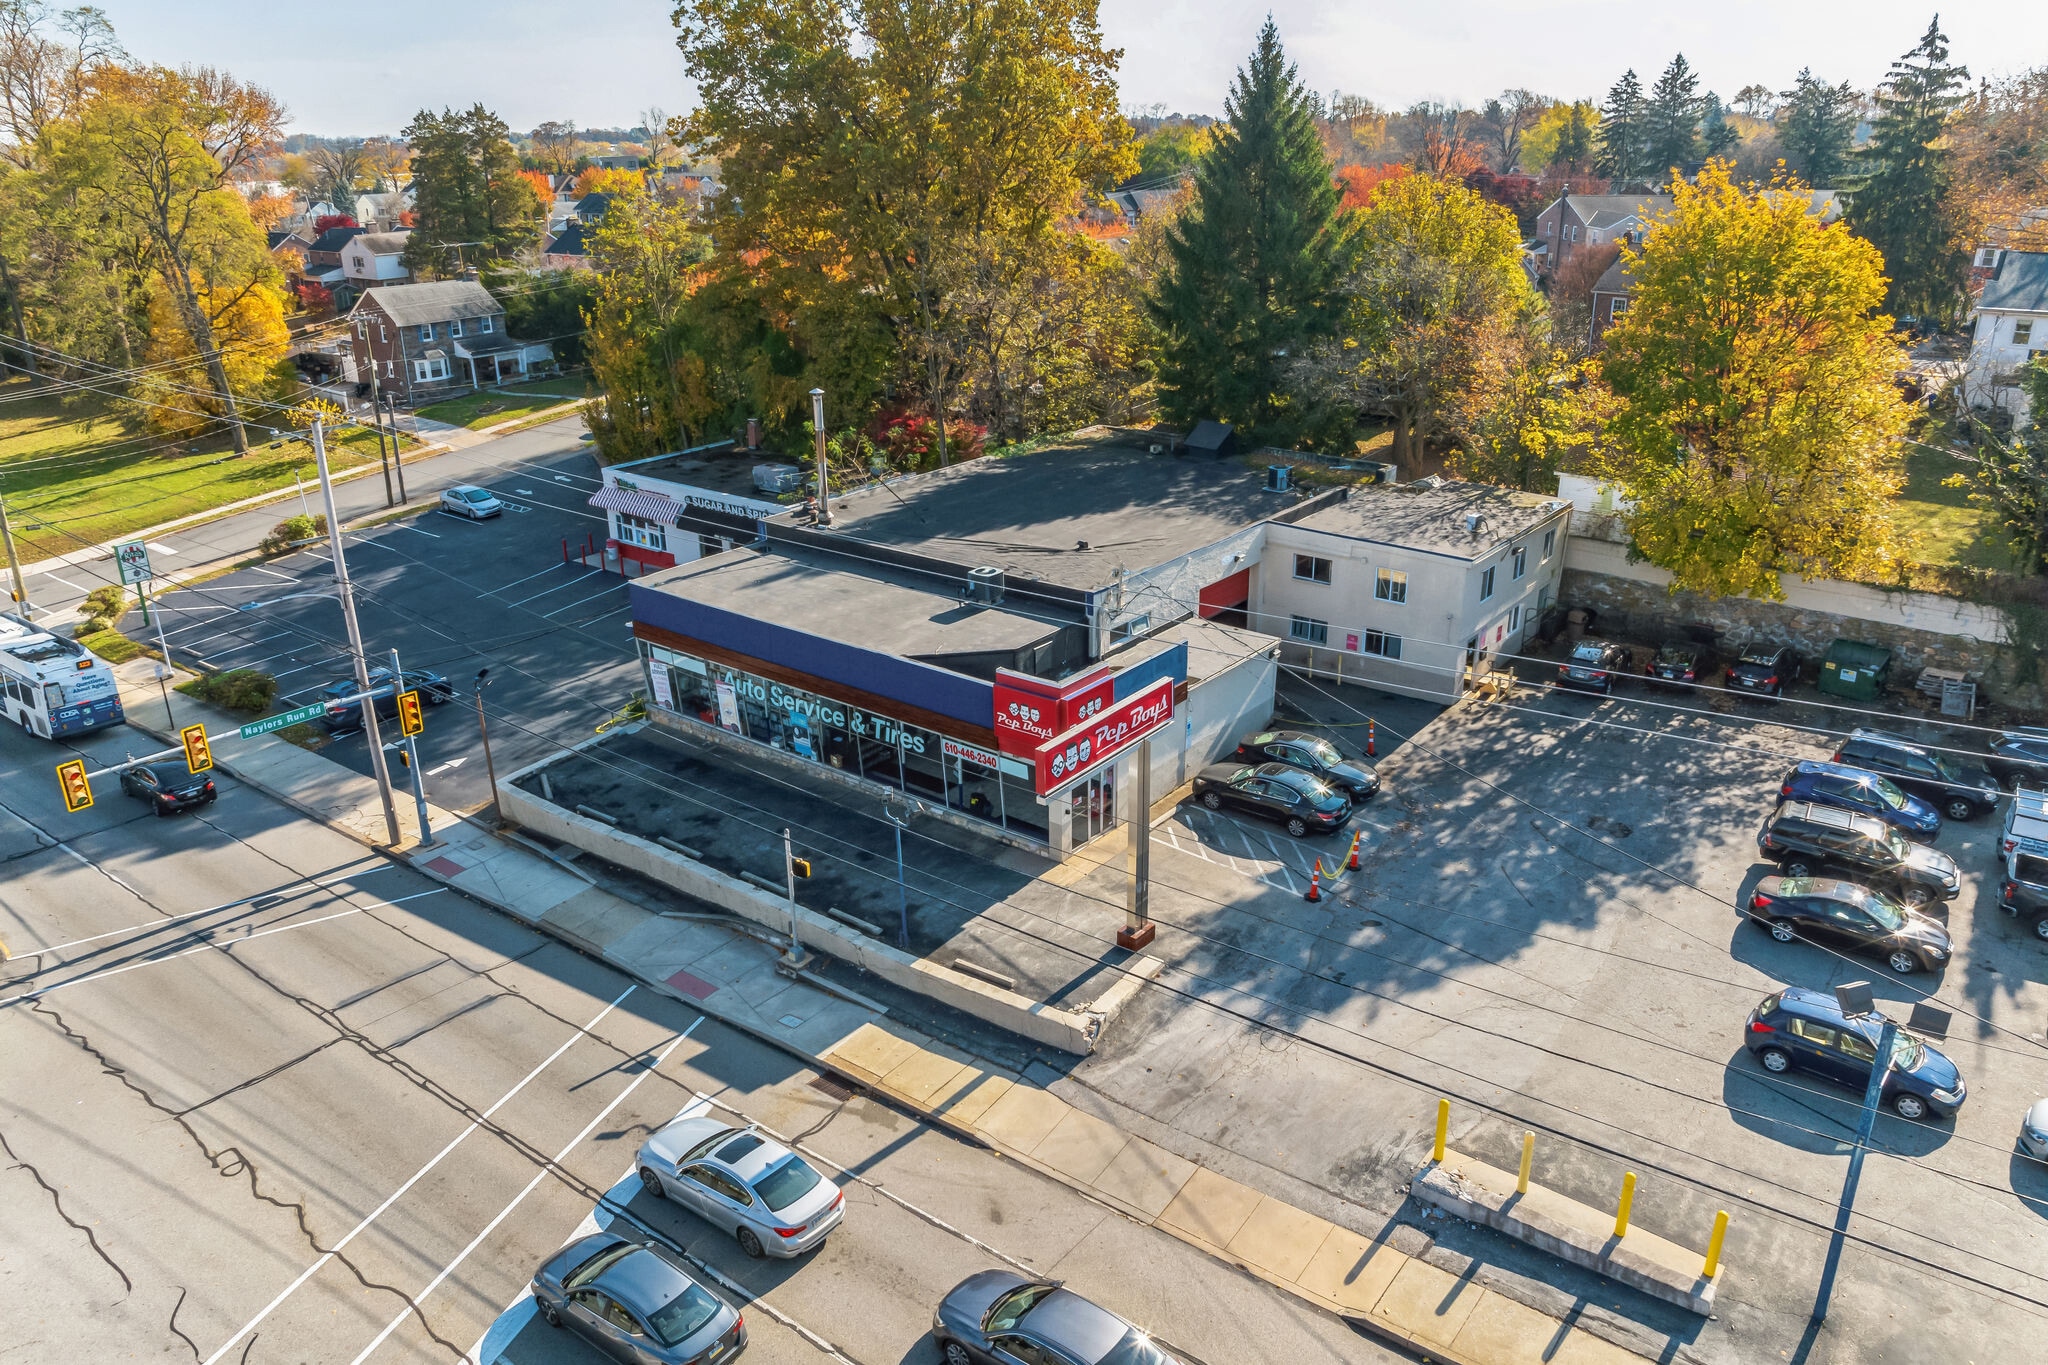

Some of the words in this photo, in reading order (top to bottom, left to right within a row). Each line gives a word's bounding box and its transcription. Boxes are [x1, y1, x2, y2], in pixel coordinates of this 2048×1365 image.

[692, 497, 723, 512] SUGAR
[724, 504, 745, 517] AND
[746, 509, 773, 520] SPIC
[73, 684, 90, 693] About
[76, 677, 105, 688] Questions
[244, 719, 283, 736] Naylors
[286, 711, 305, 723] Run
[308, 705, 321, 716] Rd
[724, 671, 765, 700] Auto
[770, 685, 845, 727] Service
[851, 711, 866, 735] &
[871, 716, 925, 753] Tires
[1094, 721, 1129, 748] Pep
[1129, 693, 1168, 728] Boys
[997, 712, 1021, 729] Pep
[1022, 719, 1054, 740] Boys
[944, 742, 997, 768] 610-446-2340
